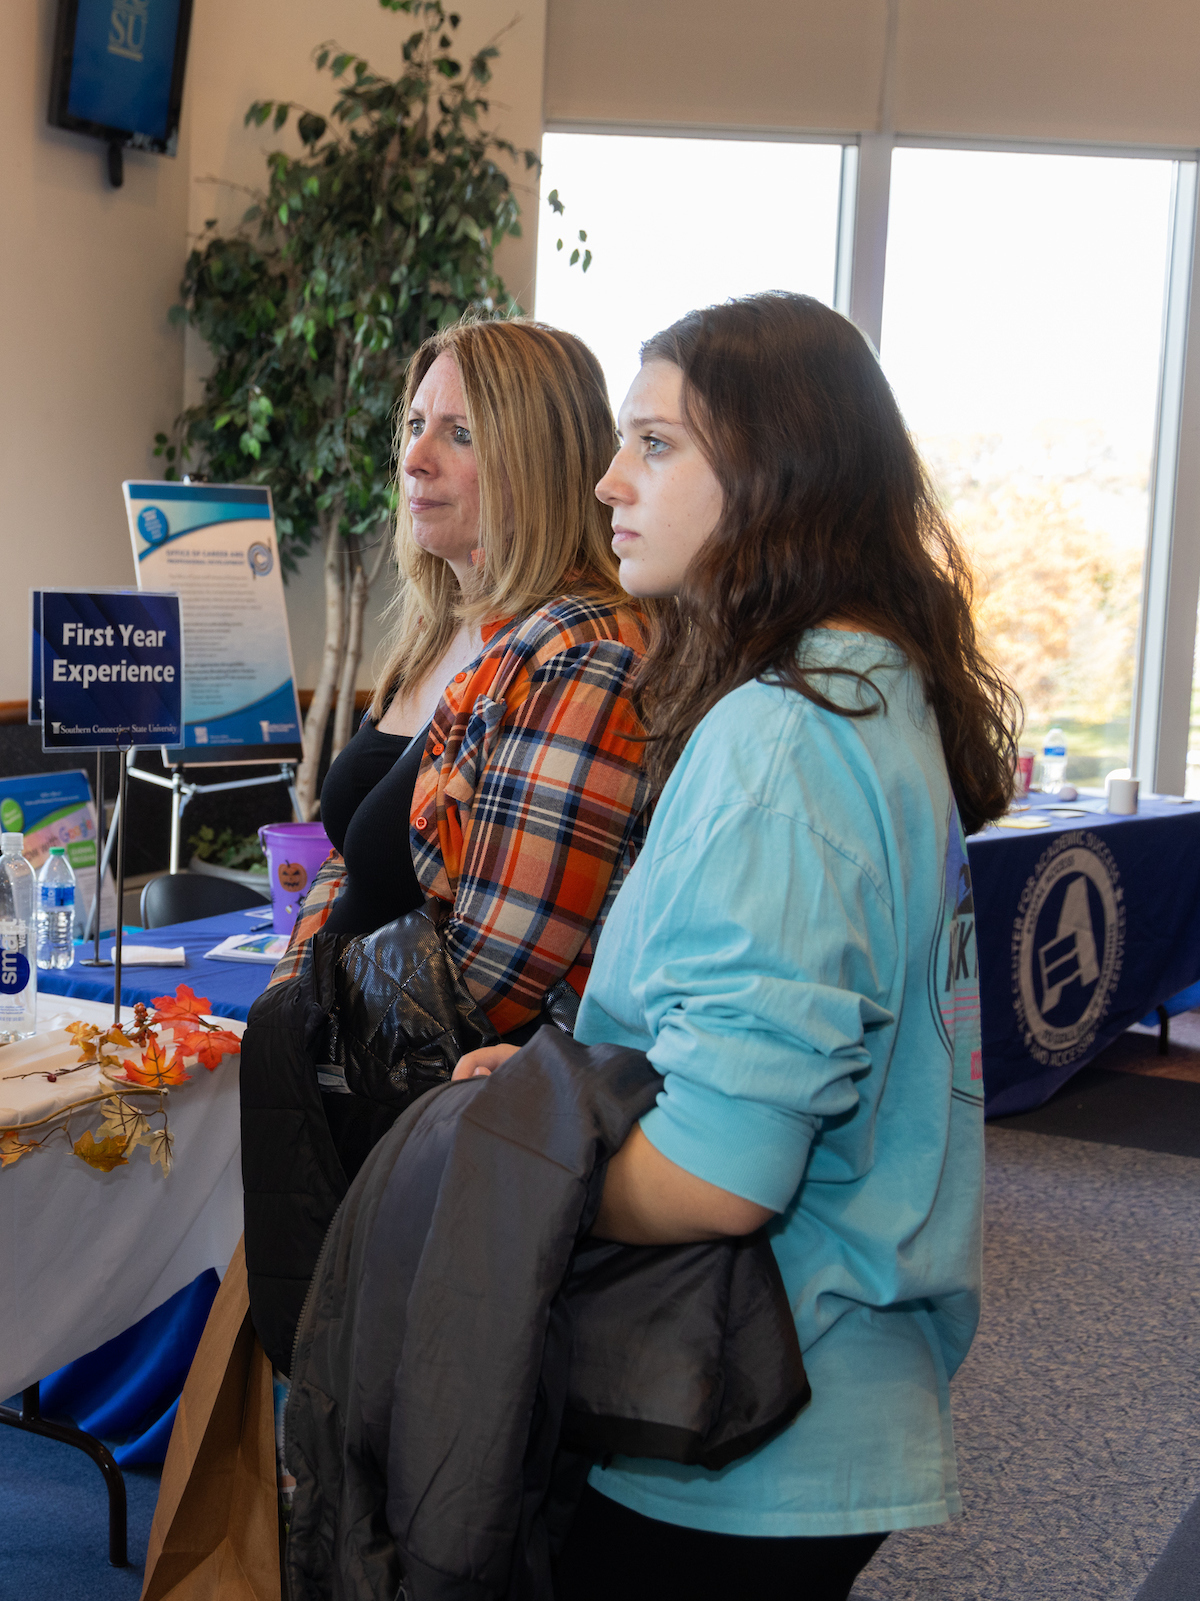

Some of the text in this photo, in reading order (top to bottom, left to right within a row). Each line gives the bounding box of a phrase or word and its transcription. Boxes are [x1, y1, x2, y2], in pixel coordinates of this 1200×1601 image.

[63, 623, 166, 647] First Year
[52, 659, 175, 689] Experience
[60, 724, 92, 734] Southern
[131, 724, 147, 733] State
[148, 723, 177, 734] University
[1010, 916, 1024, 995] CENTER
[1017, 875, 1037, 914] FOR
[1034, 830, 1086, 878] ACADEMIC
[1086, 831, 1121, 885] SUCCESS
[18, 918, 28, 949] water
[1107, 903, 1128, 993] SERVICES
[0, 918, 19, 986] smart
